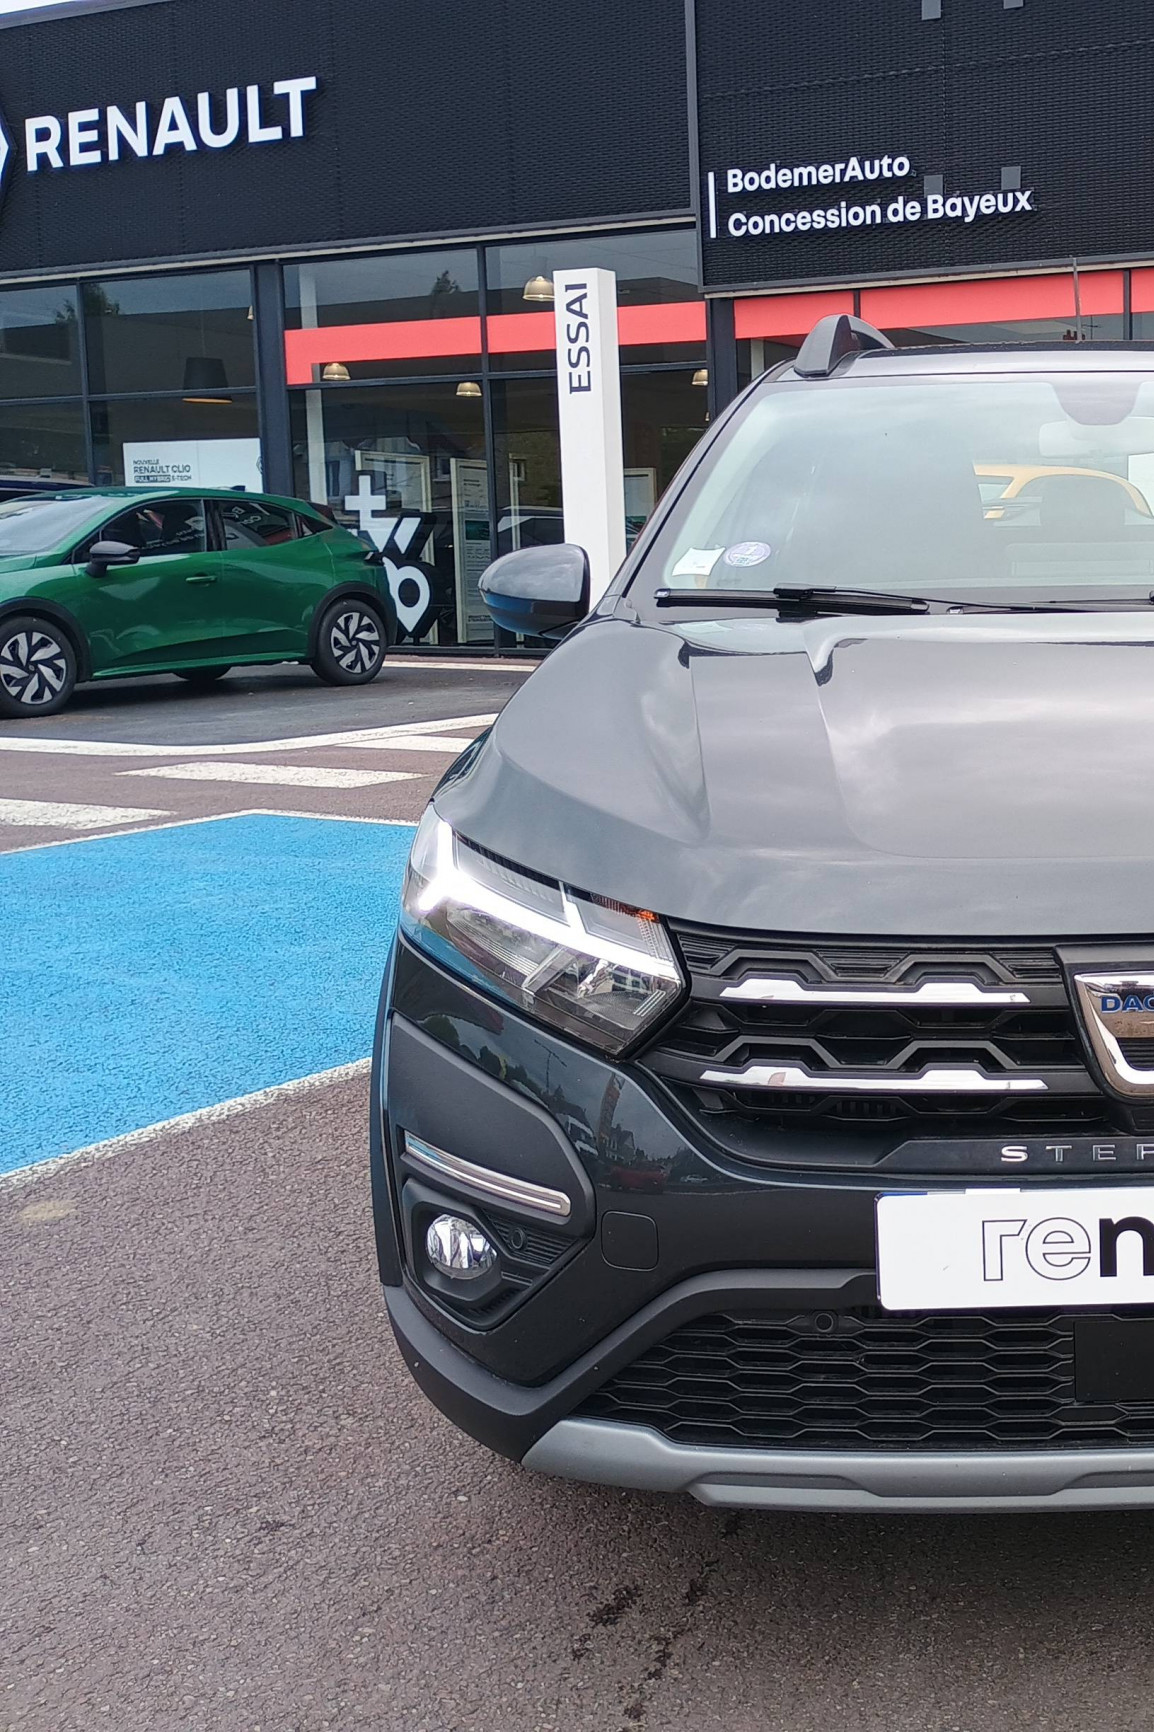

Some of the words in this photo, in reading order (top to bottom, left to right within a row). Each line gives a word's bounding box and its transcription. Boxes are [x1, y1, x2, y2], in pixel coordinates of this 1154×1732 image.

[25, 76, 316, 172] RENAULT
[727, 156, 911, 193] BodemerAuto
[728, 201, 882, 237] Concession
[887, 196, 922, 222] de
[926, 190, 1033, 223] Bayeux
[564, 283, 591, 394] ESSAI
[133, 464, 170, 474] RENAULT
[171, 464, 192, 473] CLIO
